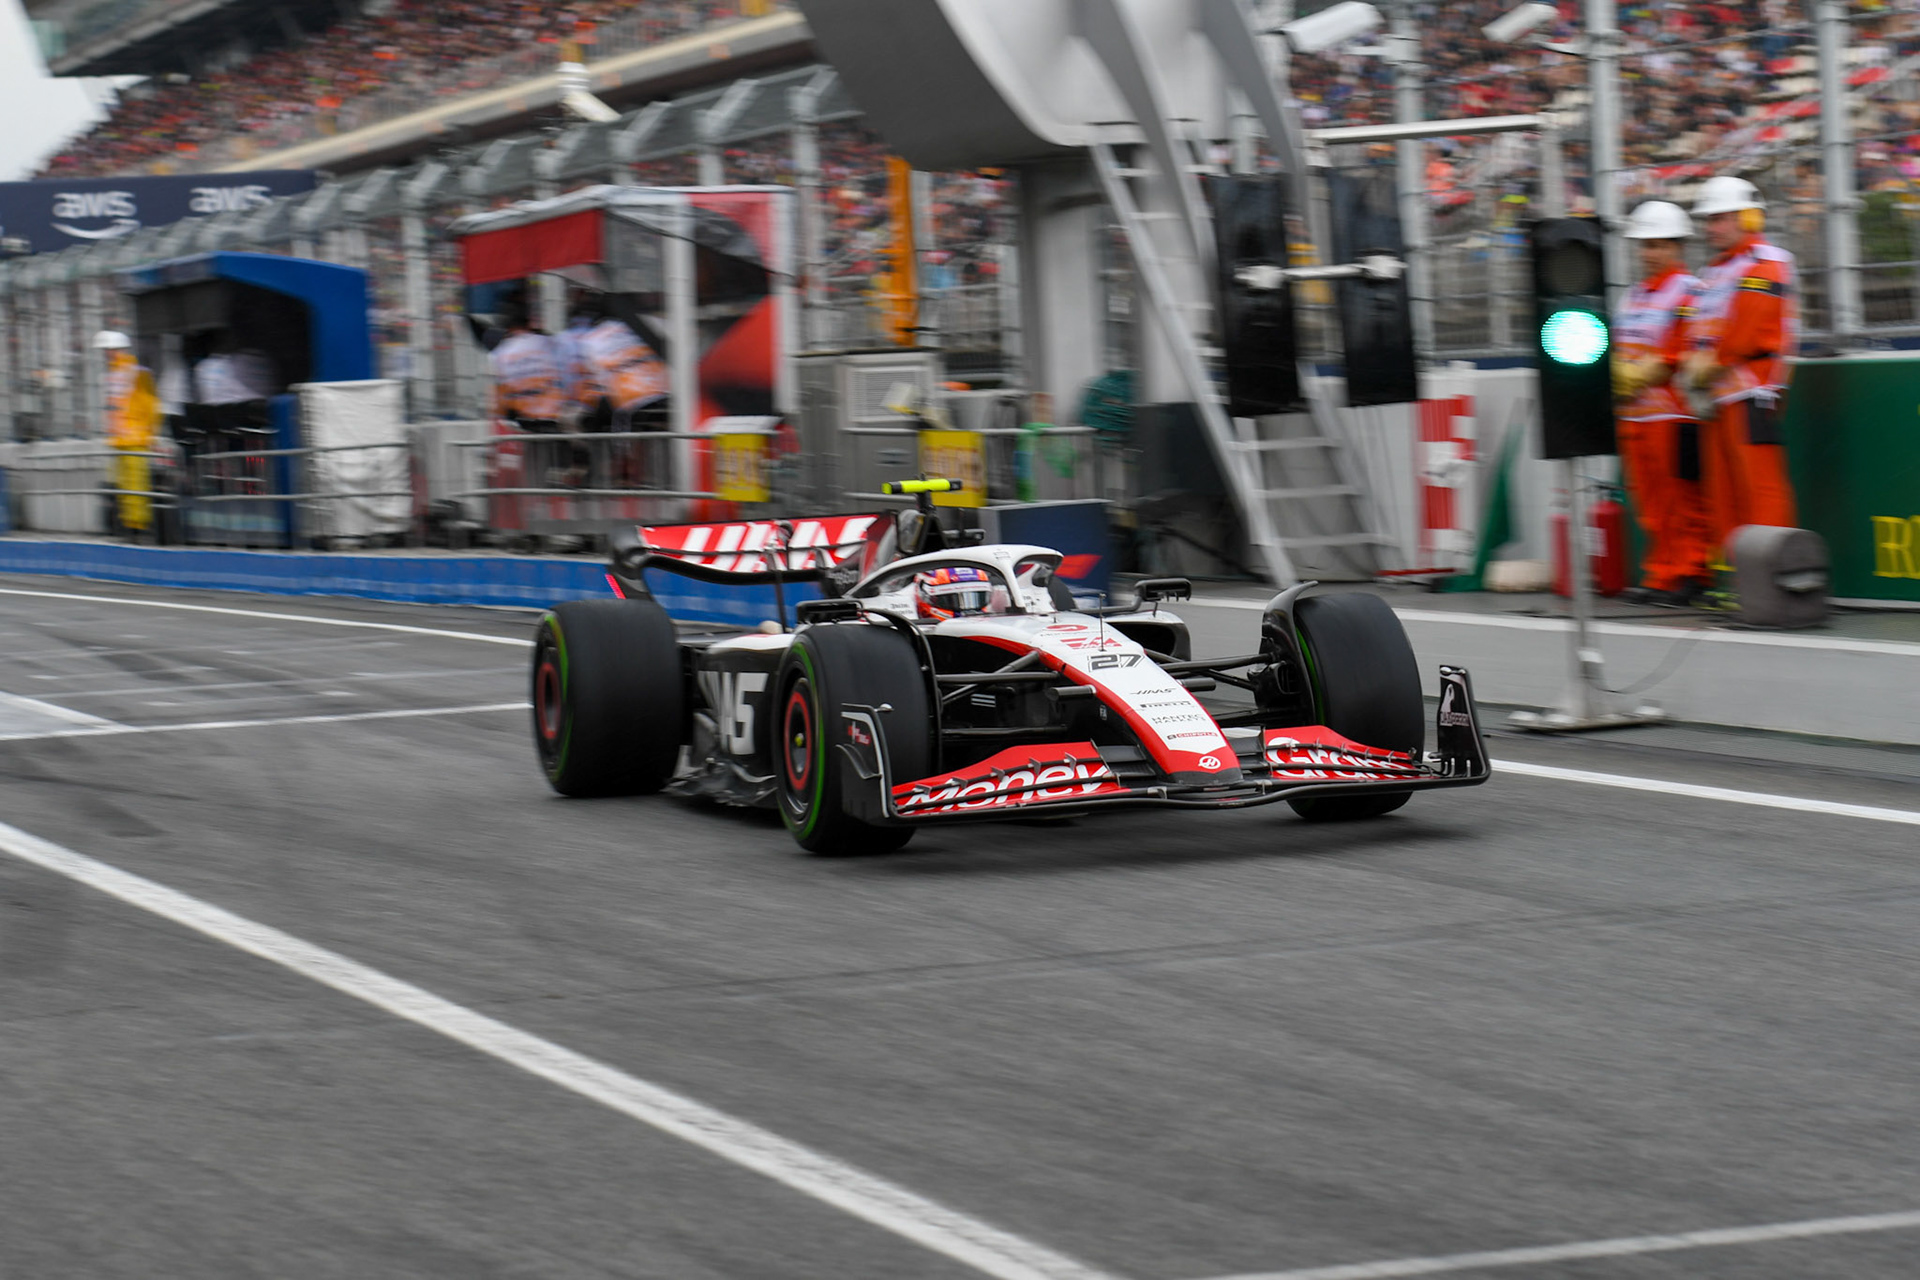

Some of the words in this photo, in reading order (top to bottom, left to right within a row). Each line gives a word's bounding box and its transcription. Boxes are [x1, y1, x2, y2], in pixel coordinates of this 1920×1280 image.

[52, 190, 138, 218] aws
[1087, 653, 1145, 672] 27
[1131, 687, 1176, 695] HAAS
[903, 764, 1108, 815] Money
